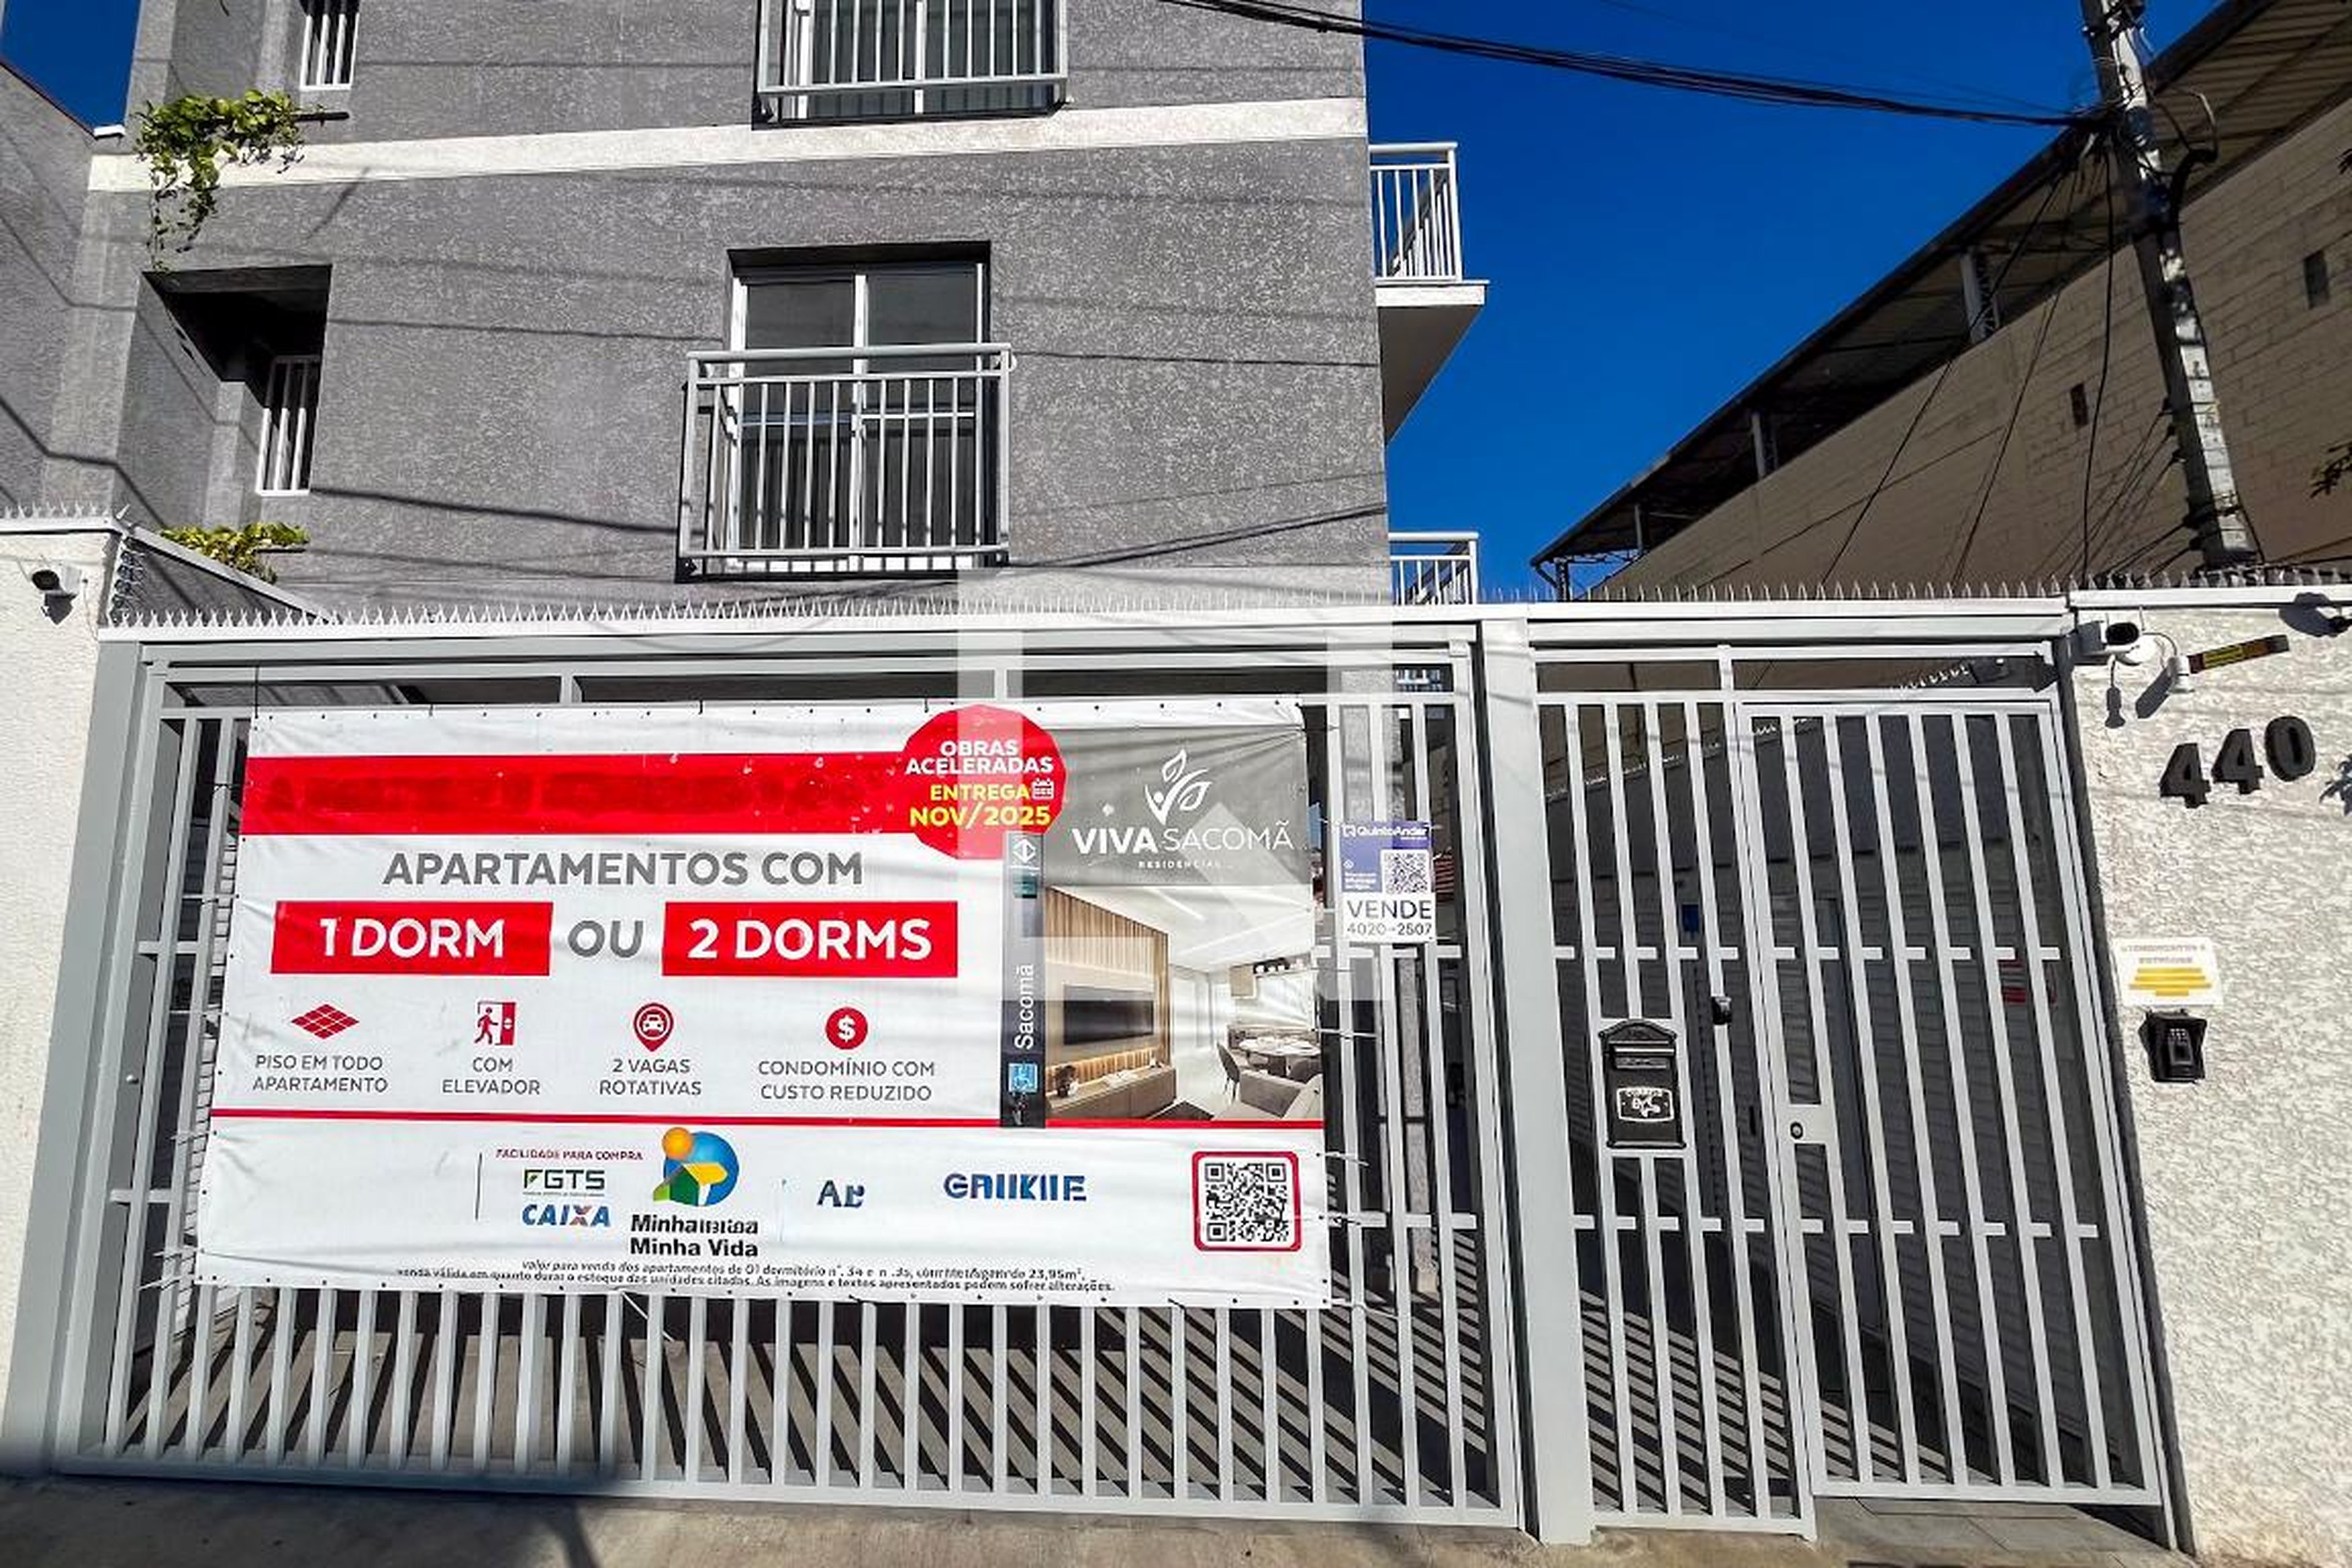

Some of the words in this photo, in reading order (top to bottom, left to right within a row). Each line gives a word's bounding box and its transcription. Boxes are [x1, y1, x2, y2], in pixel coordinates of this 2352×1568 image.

[940, 740, 1019, 756] OBRAS
[905, 756, 1054, 775] ACELERADAS
[2159, 715, 2316, 809] 440
[930, 784, 1030, 801] ENTREGA
[910, 802, 1050, 829] NOV/2025
[1071, 827, 1158, 854] VIVA
[1164, 820, 1294, 851] SACOMÃ
[382, 852, 748, 885] APARTAMENTOS
[761, 852, 863, 885] COM
[1347, 900, 1432, 919] VENDE
[320, 918, 336, 957] 1
[352, 918, 505, 958] DORM
[567, 920, 644, 959] OU
[687, 919, 720, 959] 2
[735, 919, 932, 960] DORMS
[1014, 963, 1035, 1050] Sacomã
[255, 1055, 296, 1071] PISO
[301, 1055, 327, 1071] EM
[333, 1055, 383, 1071] TODO
[472, 1057, 513, 1072] COM
[612, 1058, 624, 1072] 2
[627, 1058, 691, 1074] VAGAS
[758, 1058, 887, 1077] CONDOMÍNIO
[892, 1061, 936, 1077] COM
[252, 1077, 388, 1093] APARTAMENTO
[442, 1079, 541, 1095] ELEVADOR
[599, 1079, 702, 1096] ROTATIVAS
[761, 1084, 824, 1100] CUSTO
[830, 1085, 932, 1101] REDUZIDO
[496, 1148, 559, 1159] FACILIDADE
[562, 1150, 594, 1160] PARA
[595, 1150, 643, 1161] COMPRA
[524, 1169, 605, 1190] FGTS
[522, 1204, 611, 1227] CAIXA
[630, 1237, 701, 1256] Minha
[707, 1238, 759, 1257] Vida
[552, 1262, 579, 1272] para
[618, 1262, 640, 1272] dos
[643, 1264, 725, 1275] apartamentos
[577, 1273, 624, 1284] estoque
[626, 1273, 647, 1283] das
[650, 1273, 705, 1285] unidades
[757, 1275, 771, 1286] As
[775, 1275, 825, 1289] imagens
[838, 1278, 876, 1287] textos
[878, 1280, 961, 1289] apresentados
[1010, 1279, 1046, 1291] sofrer
